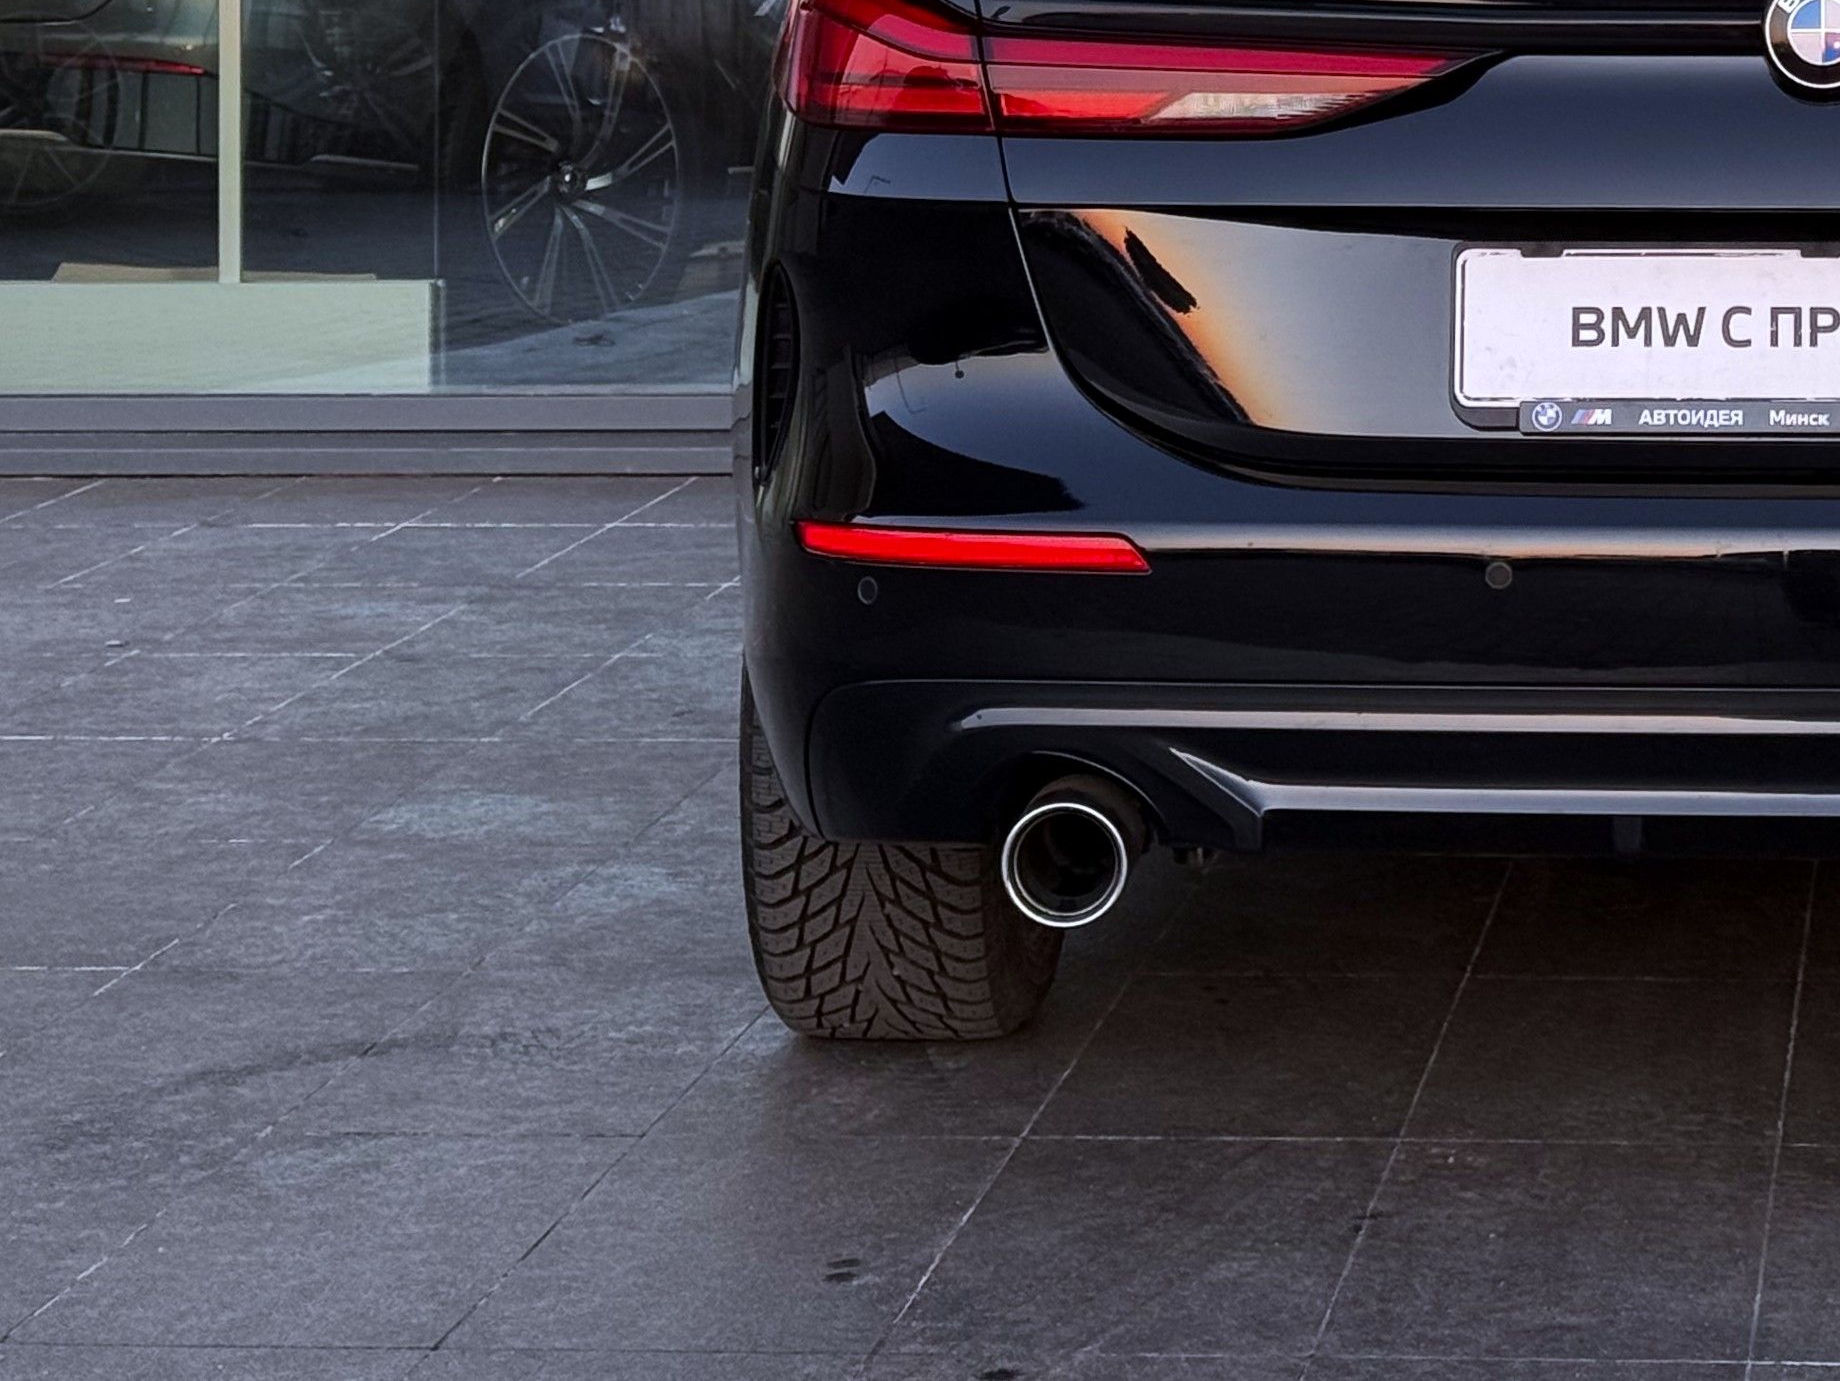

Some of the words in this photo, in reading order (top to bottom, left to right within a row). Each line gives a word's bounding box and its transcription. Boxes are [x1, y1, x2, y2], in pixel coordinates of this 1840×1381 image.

[1571, 306, 1707, 348] BMW
[1721, 305, 1752, 349] С
[1638, 409, 1744, 428] АВТОИДЕЯ
[1769, 409, 1831, 426] Минск
